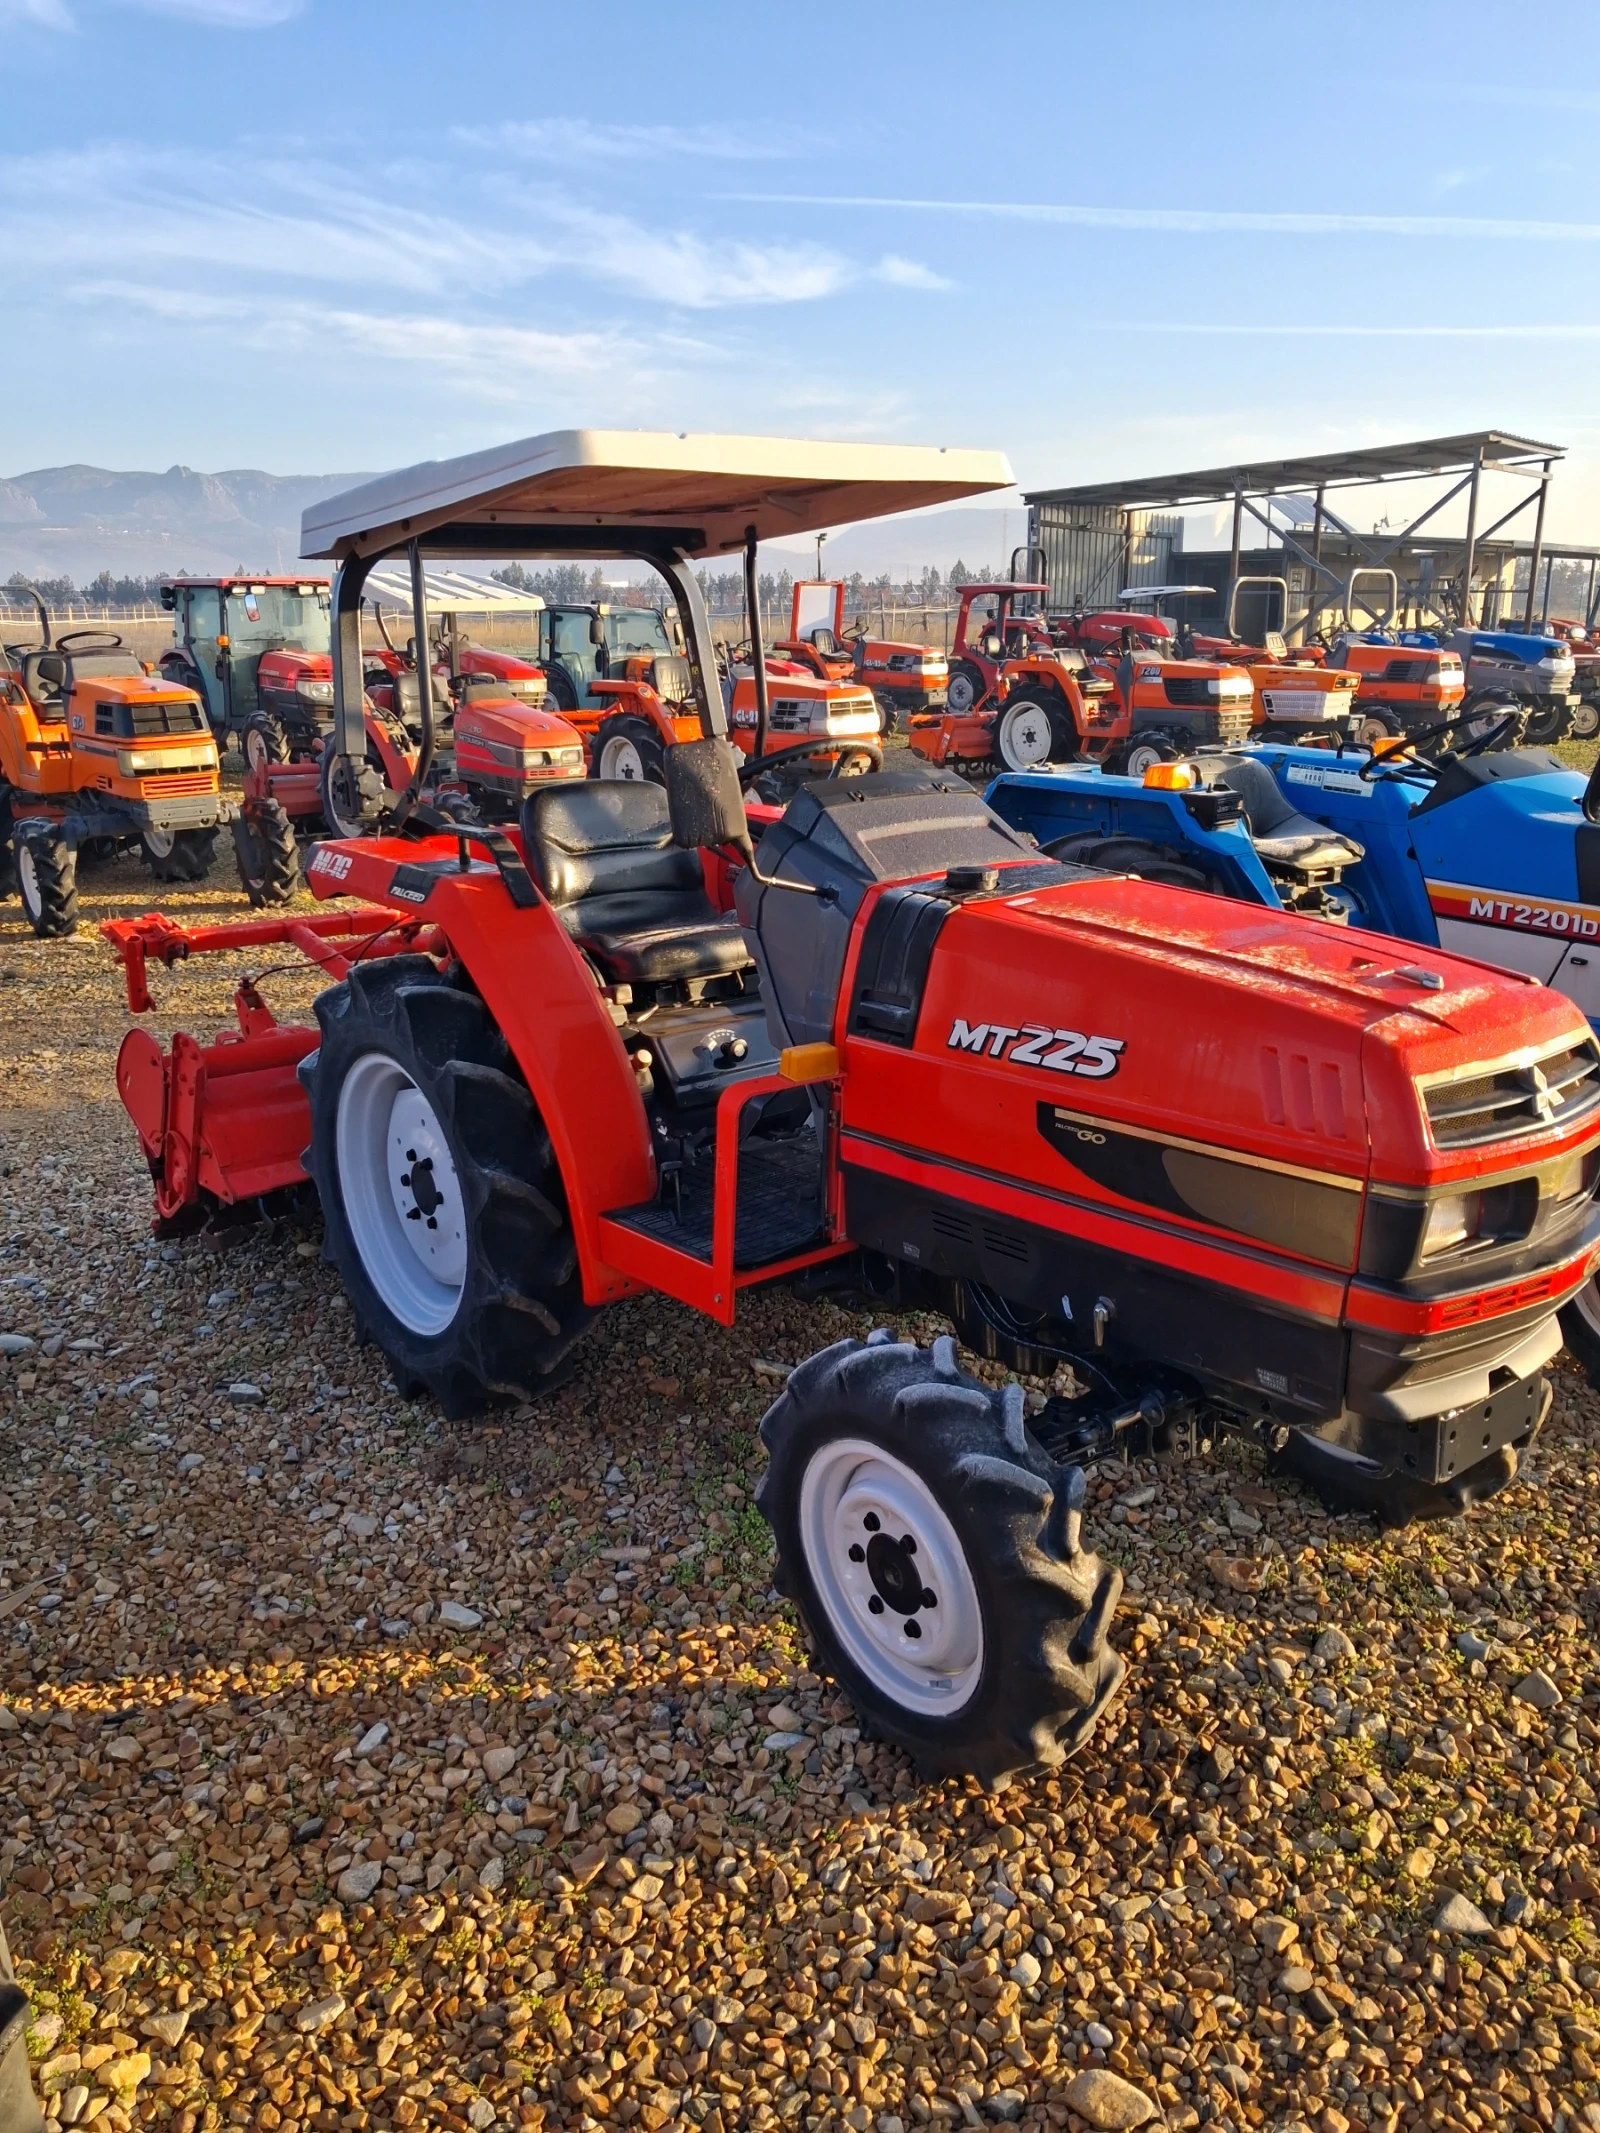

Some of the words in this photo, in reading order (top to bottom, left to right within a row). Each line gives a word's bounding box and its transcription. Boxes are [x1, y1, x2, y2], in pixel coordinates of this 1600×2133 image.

[390, 886, 426, 902] FALCEED
[1469, 897, 1599, 936] MT2201D
[947, 1018, 1127, 1081] MT225
[1077, 1130, 1106, 1145] GO
